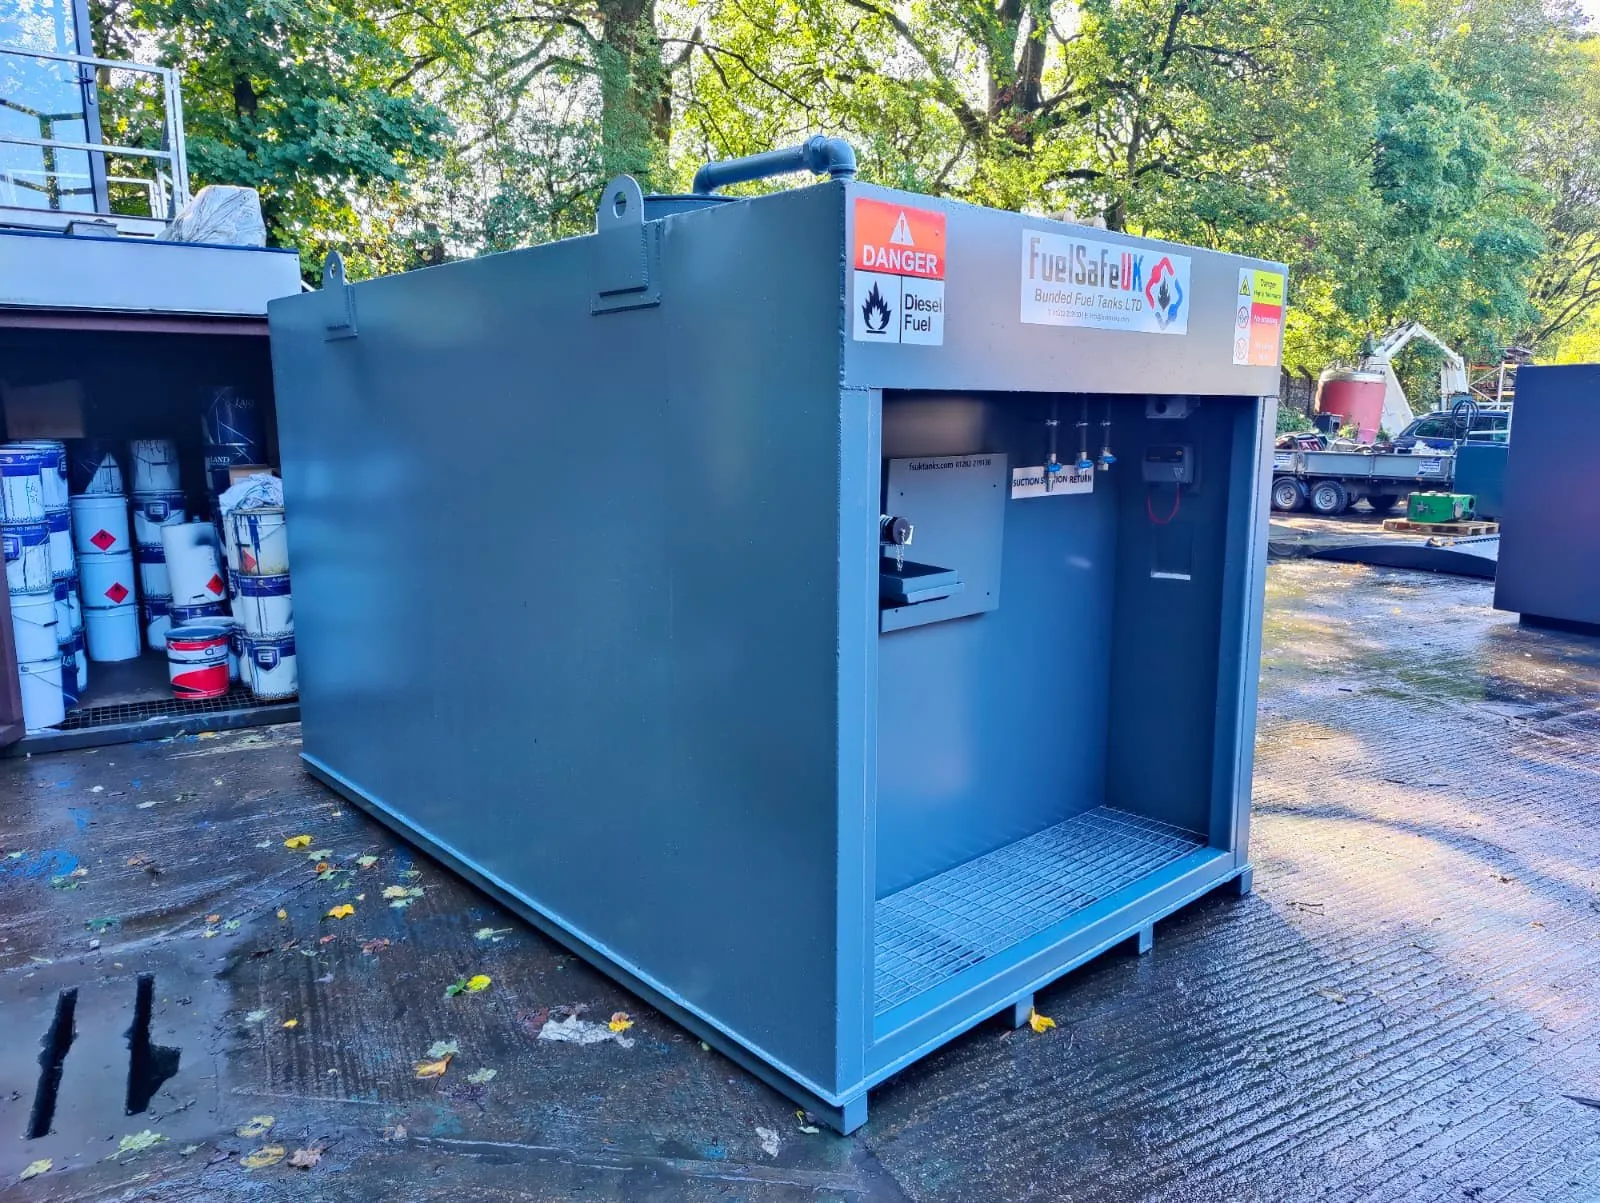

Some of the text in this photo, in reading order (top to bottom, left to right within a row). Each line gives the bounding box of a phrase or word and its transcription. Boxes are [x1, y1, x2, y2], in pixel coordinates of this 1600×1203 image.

[863, 244, 938, 275] DANGER
[1029, 237, 1144, 293] FuelSafeUK
[905, 293, 942, 313] Diesel
[1035, 287, 1143, 312] Bunded Fuel Tanks LTD
[904, 314, 931, 332] Fuel
[909, 461, 953, 471] fsuktanks.com
[1013, 474, 1092, 487] SUCTION STION RETURN
